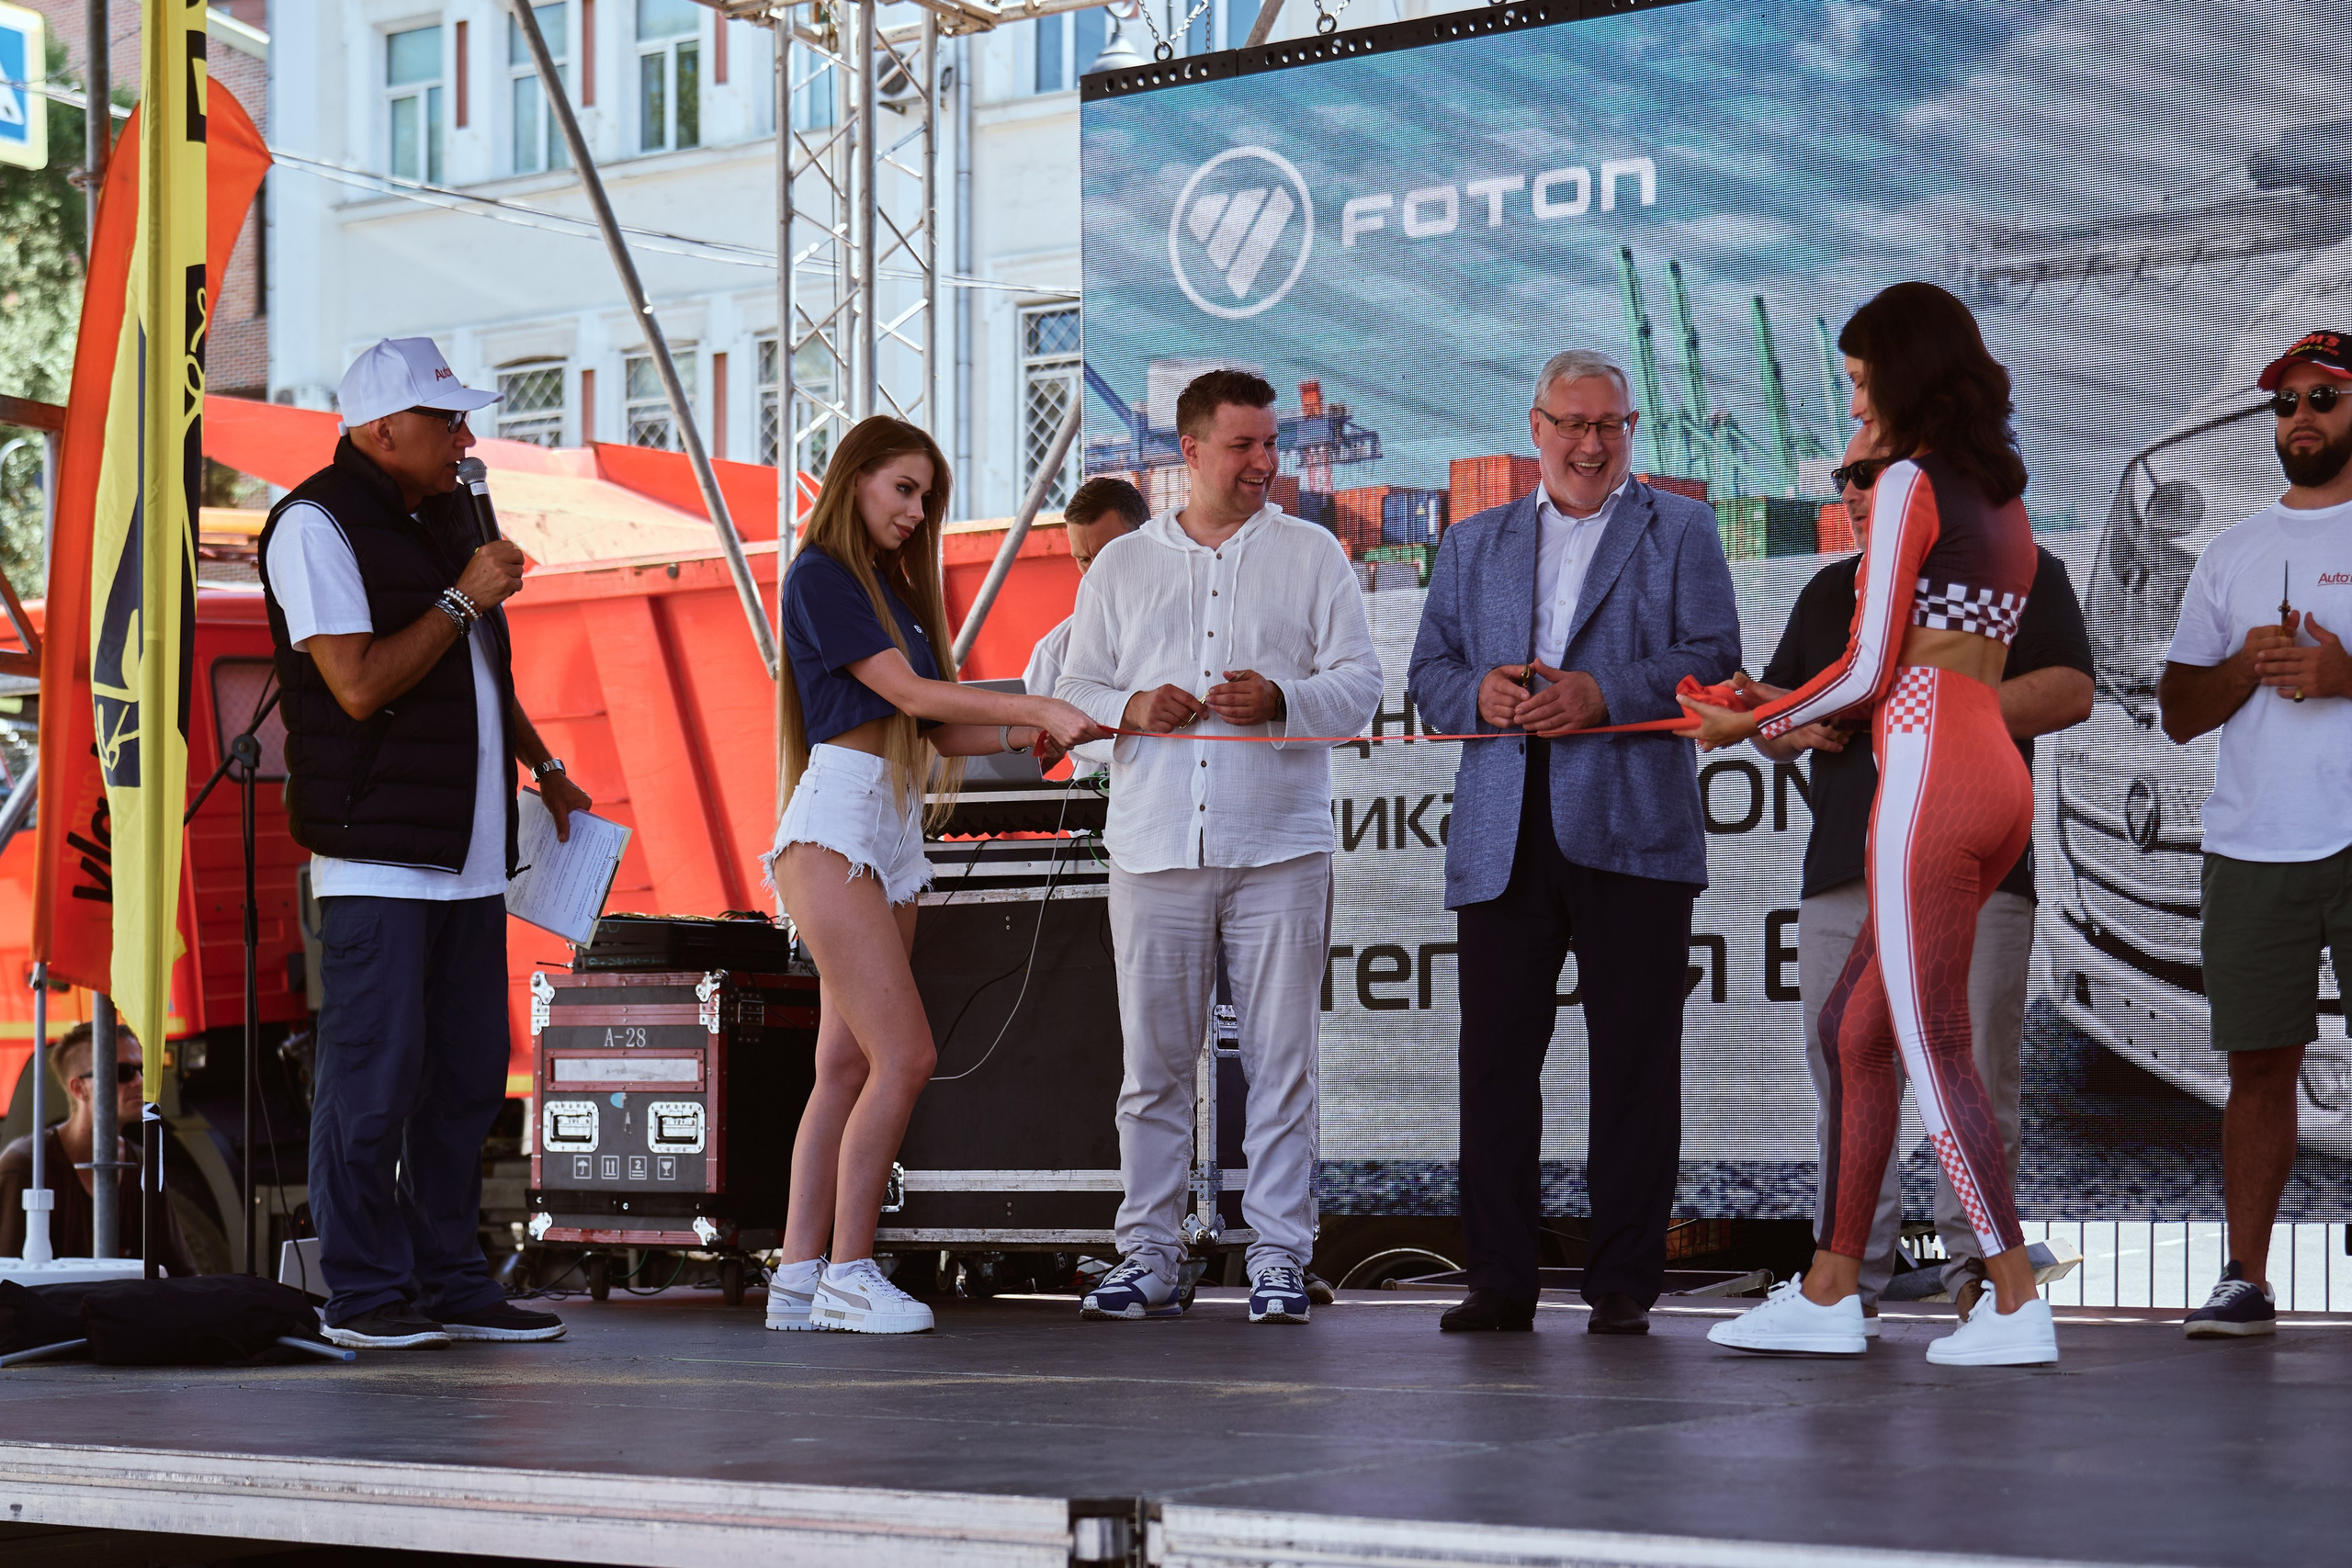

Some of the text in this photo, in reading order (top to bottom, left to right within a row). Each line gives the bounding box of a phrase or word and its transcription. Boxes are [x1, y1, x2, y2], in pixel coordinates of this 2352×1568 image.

[1341, 156, 1656, 248] FOTON
[2317, 571, 2352, 585] Auto
[604, 1027, 647, 1048] A-28
